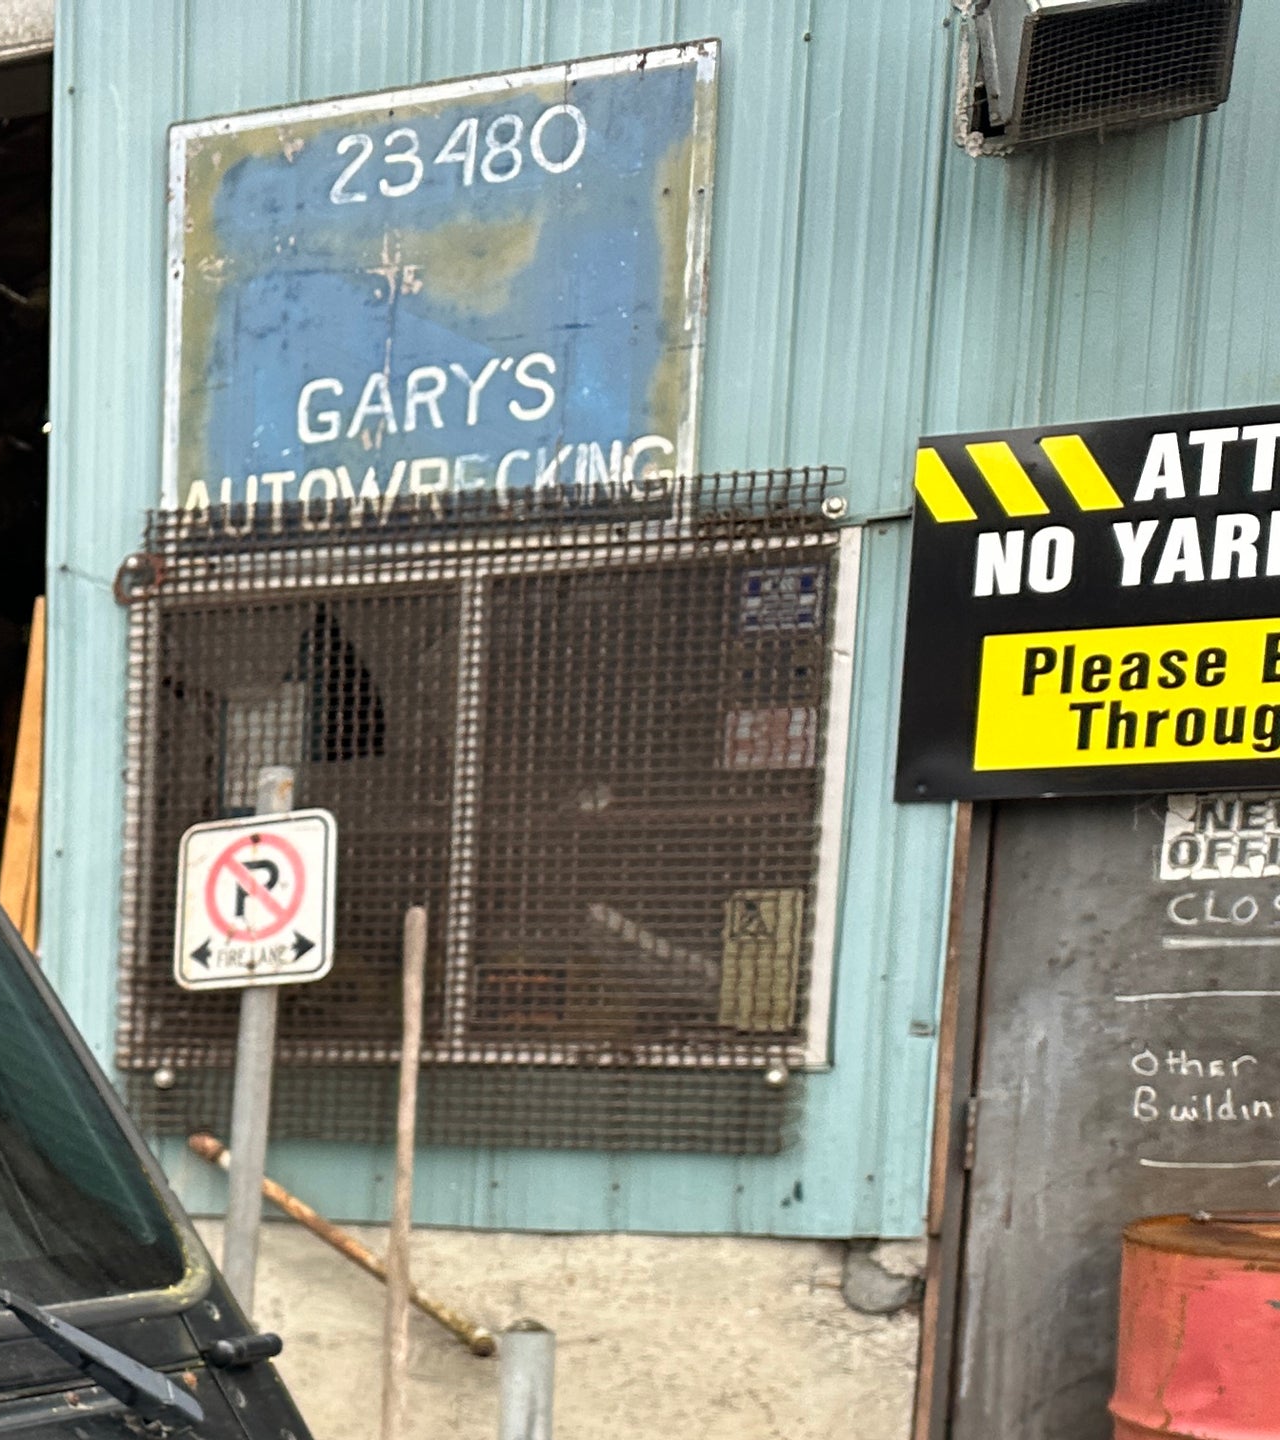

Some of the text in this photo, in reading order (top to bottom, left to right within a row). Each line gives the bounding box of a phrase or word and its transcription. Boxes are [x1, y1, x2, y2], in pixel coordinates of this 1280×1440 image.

[329, 104, 588, 204] 23480
[297, 352, 558, 444] GARY'S
[1134, 422, 1280, 502] ATT
[973, 525, 1076, 598] NO
[1022, 644, 1228, 696] Please
[1069, 700, 1280, 754] Throug
